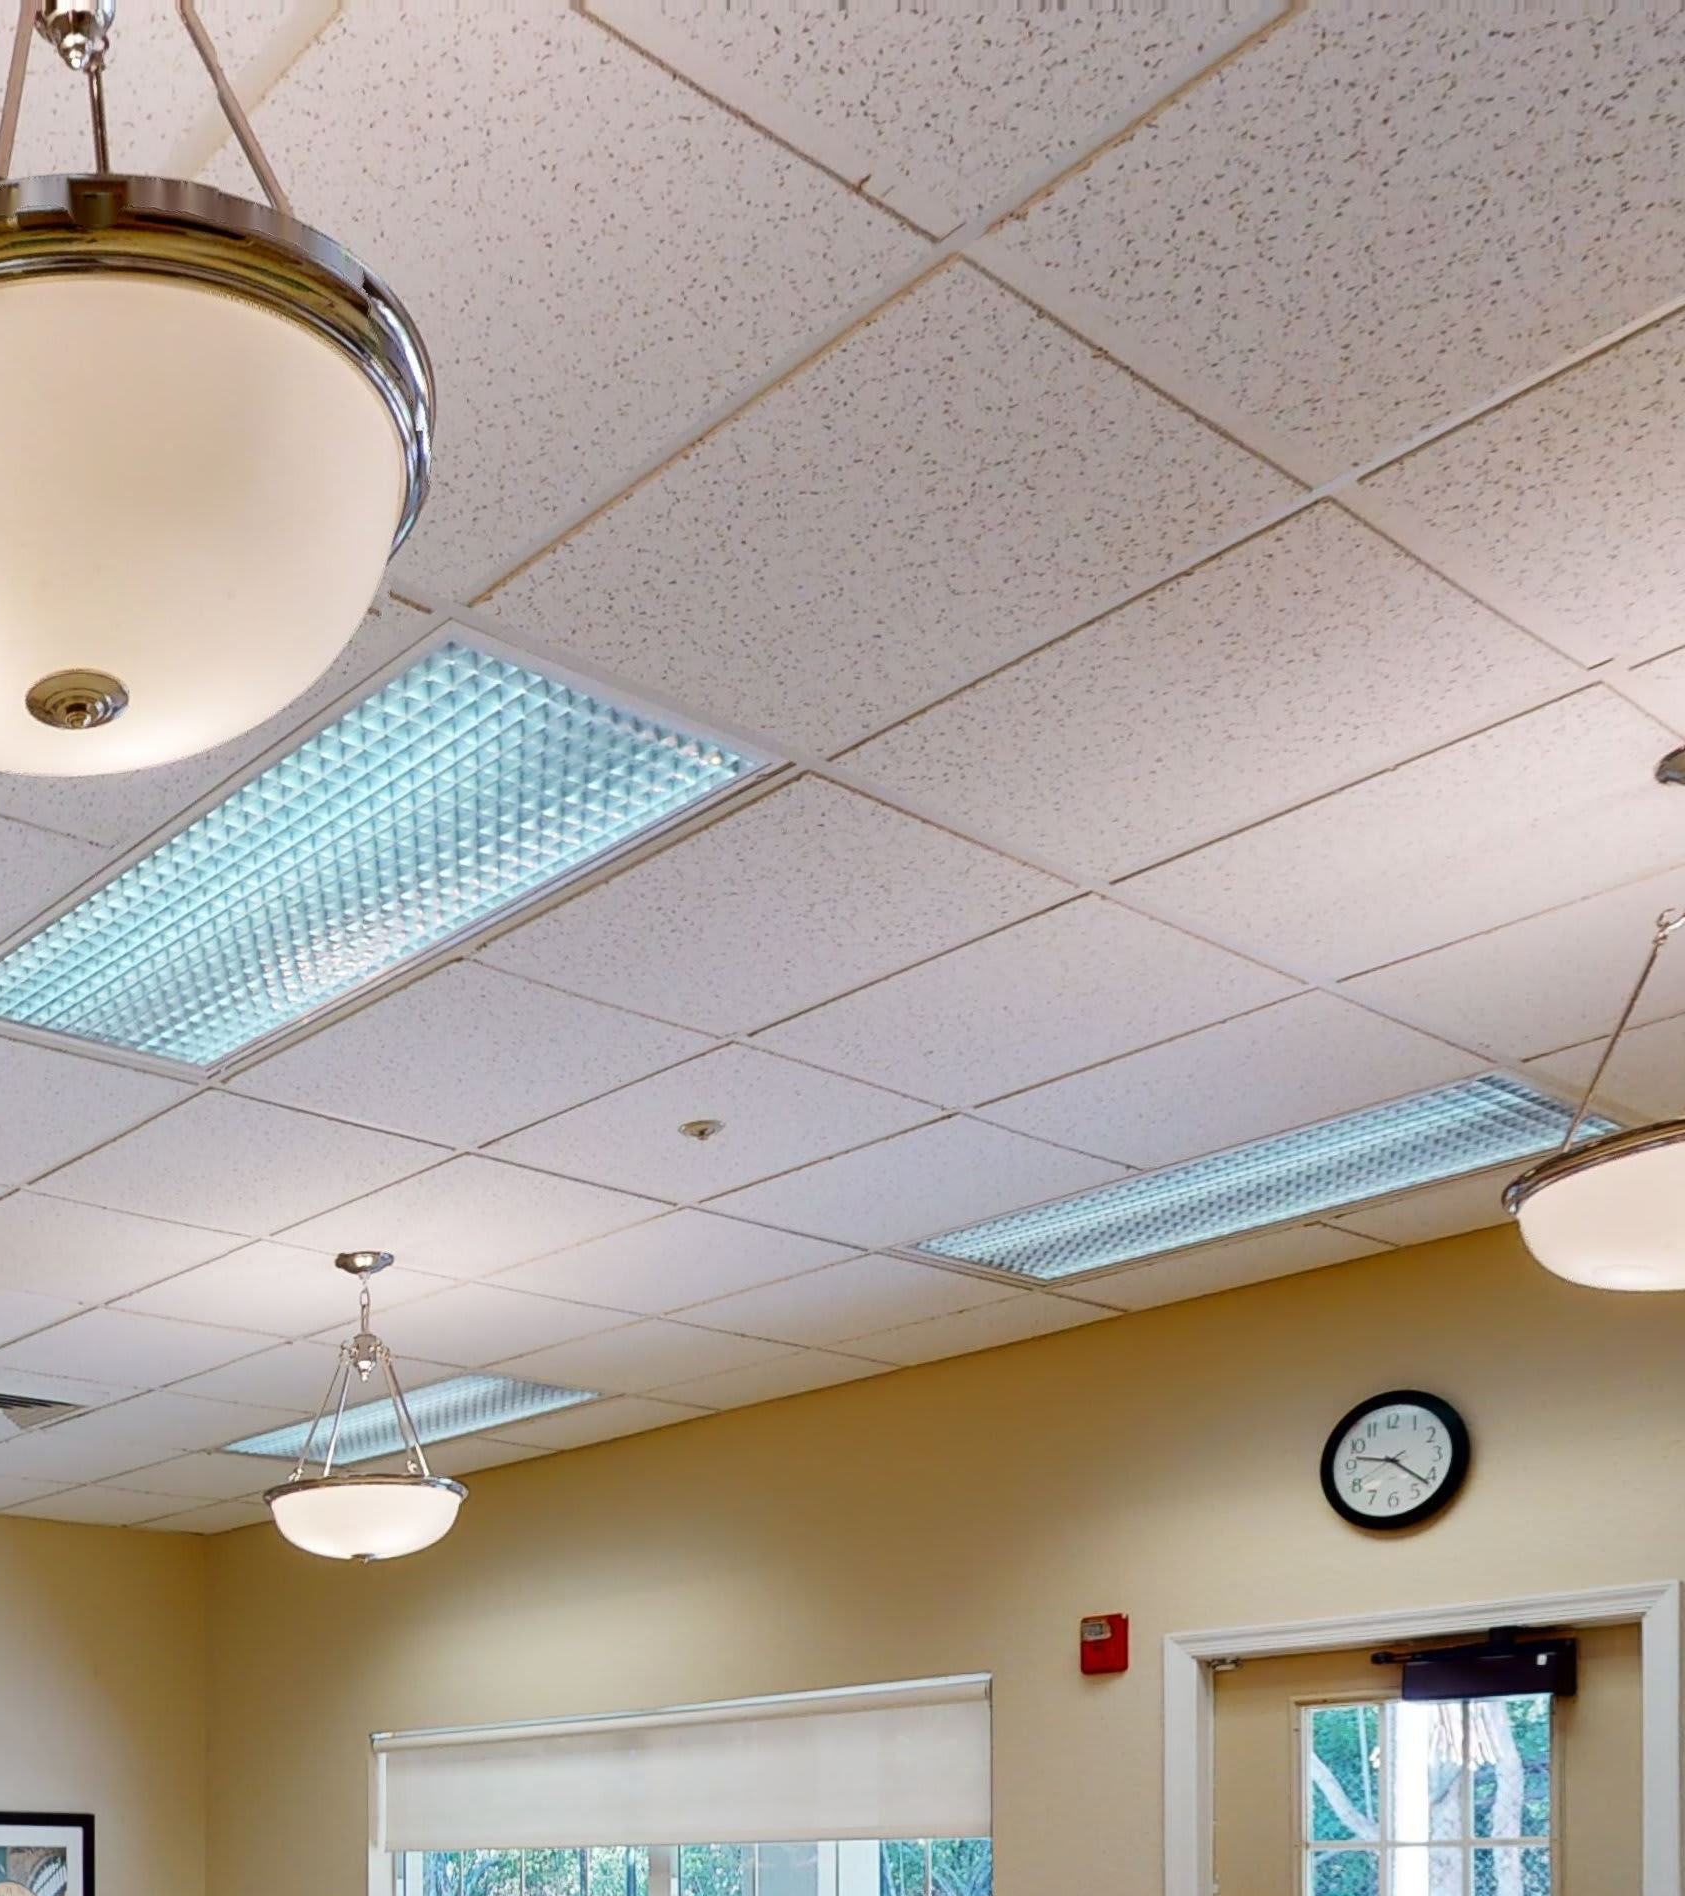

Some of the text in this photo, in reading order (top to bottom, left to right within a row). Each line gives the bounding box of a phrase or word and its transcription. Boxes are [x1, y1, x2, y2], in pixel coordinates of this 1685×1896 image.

[1367, 1422, 1377, 1438] 11
[1386, 1413, 1400, 1430] 12
[1425, 1426, 1436, 1443] 2
[1350, 1438, 1366, 1454] 10
[1432, 1445, 1443, 1462] 3
[1345, 1459, 1357, 1475] 9
[1426, 1465, 1437, 1481] 4
[1351, 1478, 1362, 1494] 8
[1409, 1482, 1421, 1500] 5
[1367, 1489, 1378, 1506] 7
[1388, 1491, 1400, 1508] 6
